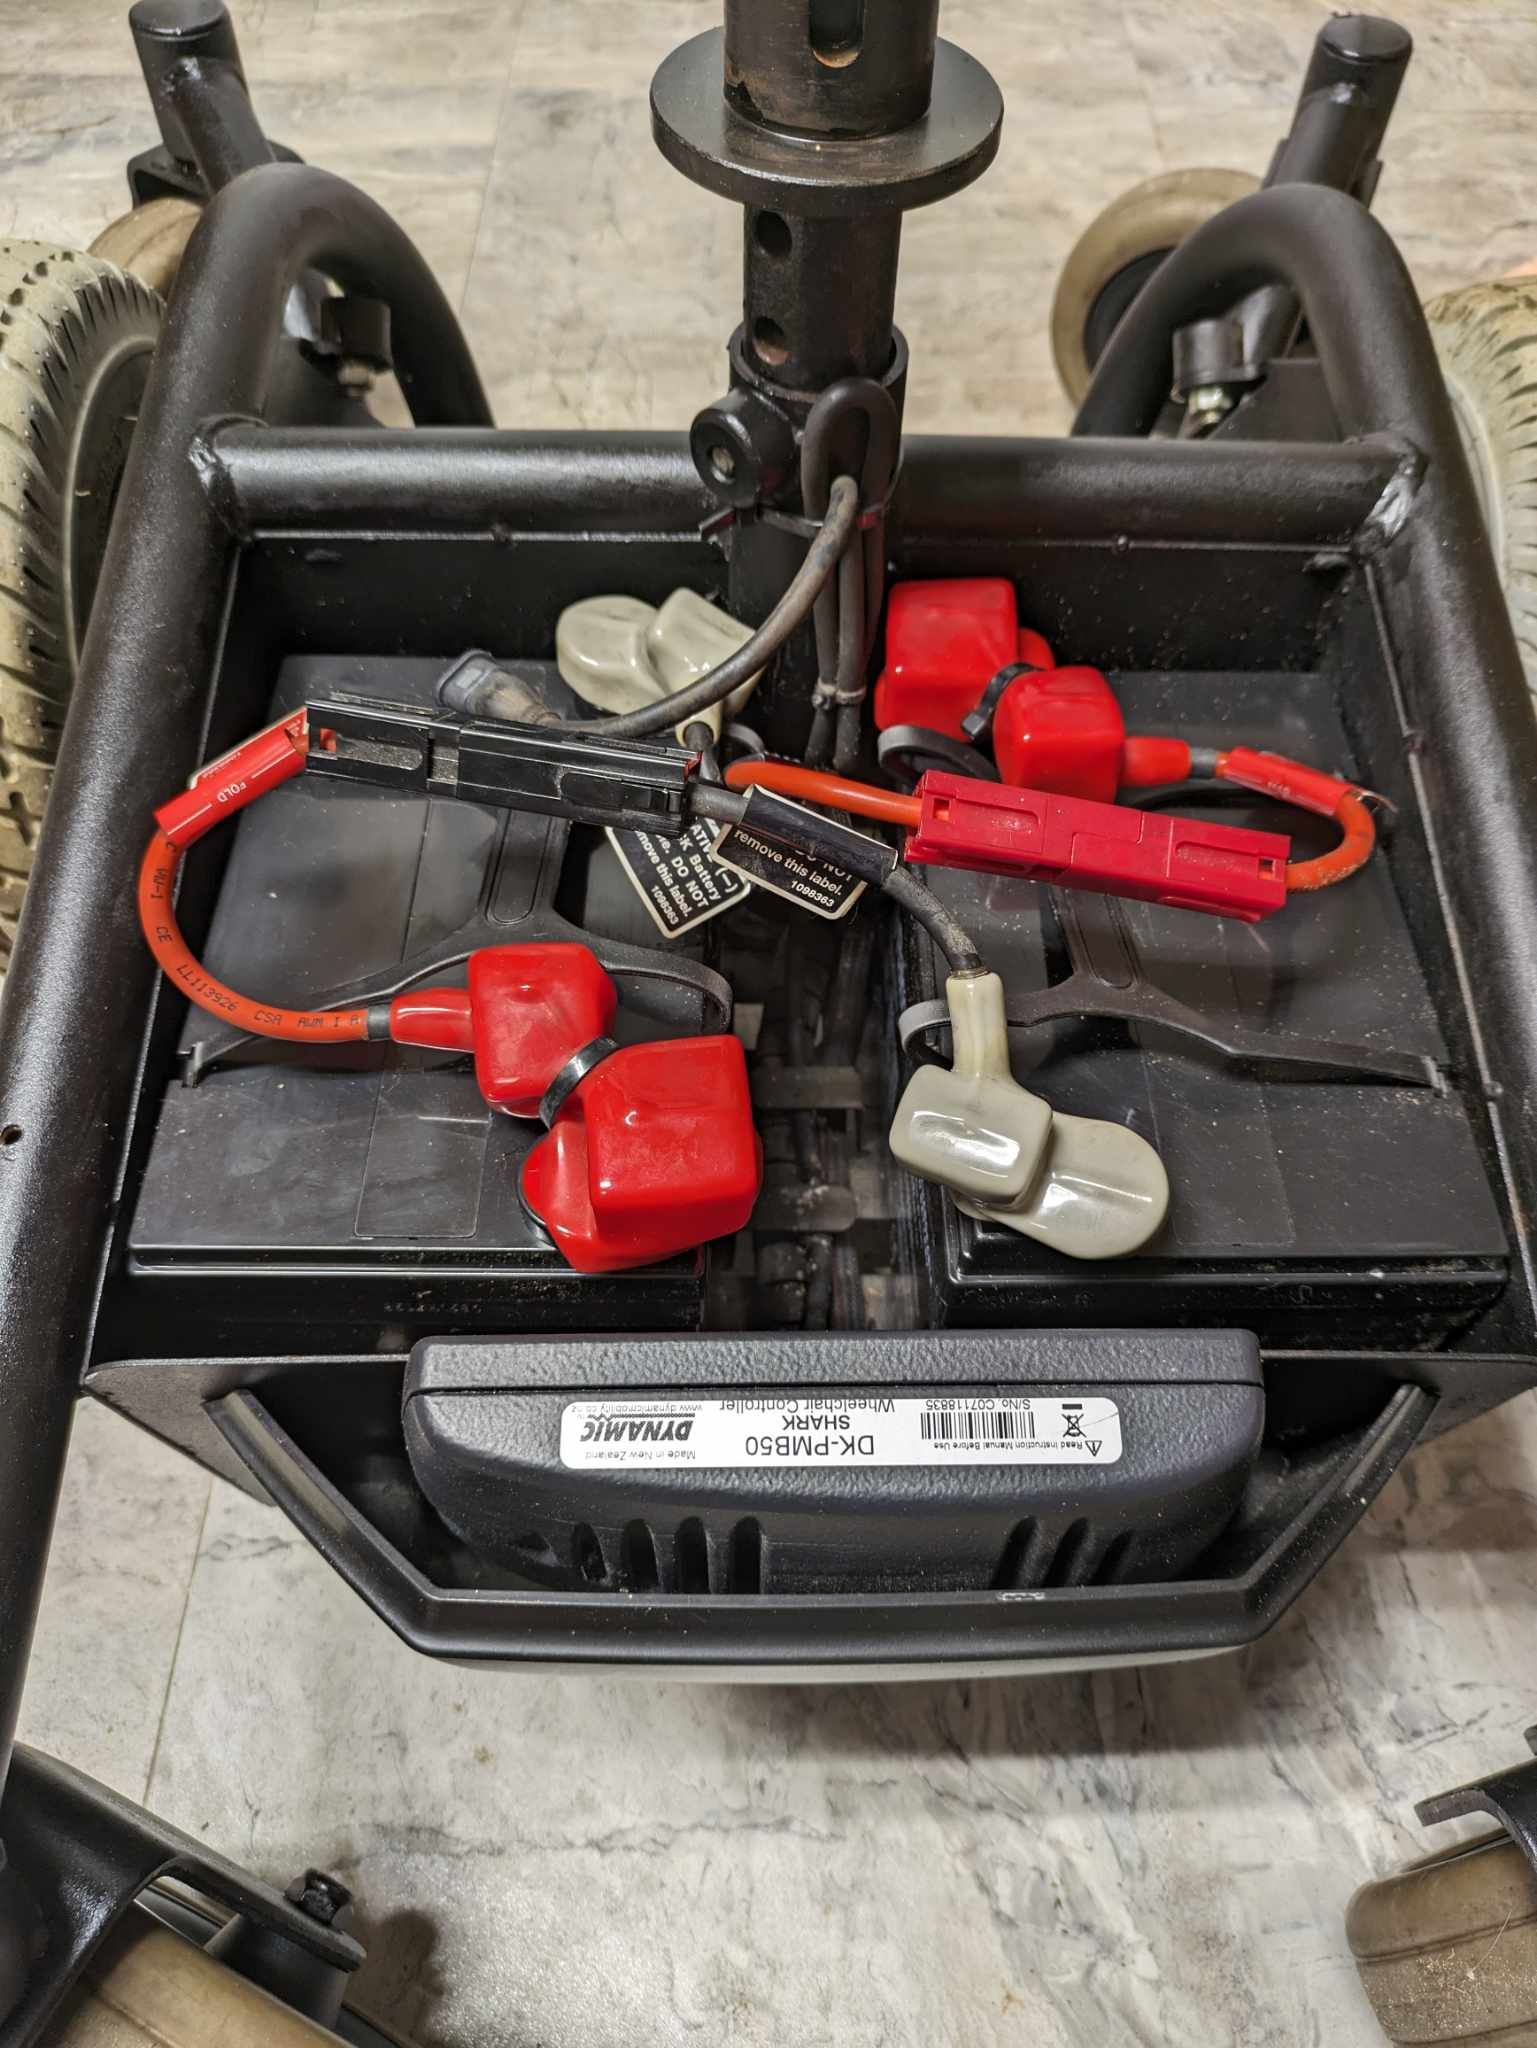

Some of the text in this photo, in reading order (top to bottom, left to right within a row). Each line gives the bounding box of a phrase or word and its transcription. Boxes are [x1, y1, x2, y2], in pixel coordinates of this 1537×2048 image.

[217, 782, 247, 802] FOLD
[734, 829, 783, 863] remove
[784, 857, 809, 877] this
[808, 871, 842, 896] label.
[671, 856, 689, 877] DO
[685, 880, 709, 908] NOT
[689, 854, 722, 901] Battery
[656, 863, 673, 887] this
[669, 885, 692, 917] label.
[791, 880, 835, 908] 1098363
[651, 885, 679, 925] 1098363
[156, 926, 173, 943] CE
[176, 963, 240, 1012] LL113926
[253, 1009, 283, 1026] CSA
[720, 1400, 895, 1414] Wheelchair Controller
[925, 1399, 995, 1410] C07118835
[580, 1420, 694, 1442] DYNAMIC
[782, 1414, 851, 1431] SHARK
[585, 1450, 626, 1461] Zealand
[629, 1451, 653, 1460] New
[667, 1450, 696, 1460] Made
[746, 1435, 874, 1456] DK-PMB50
[933, 1441, 1082, 1450] Read Instruction Manual Before Use
